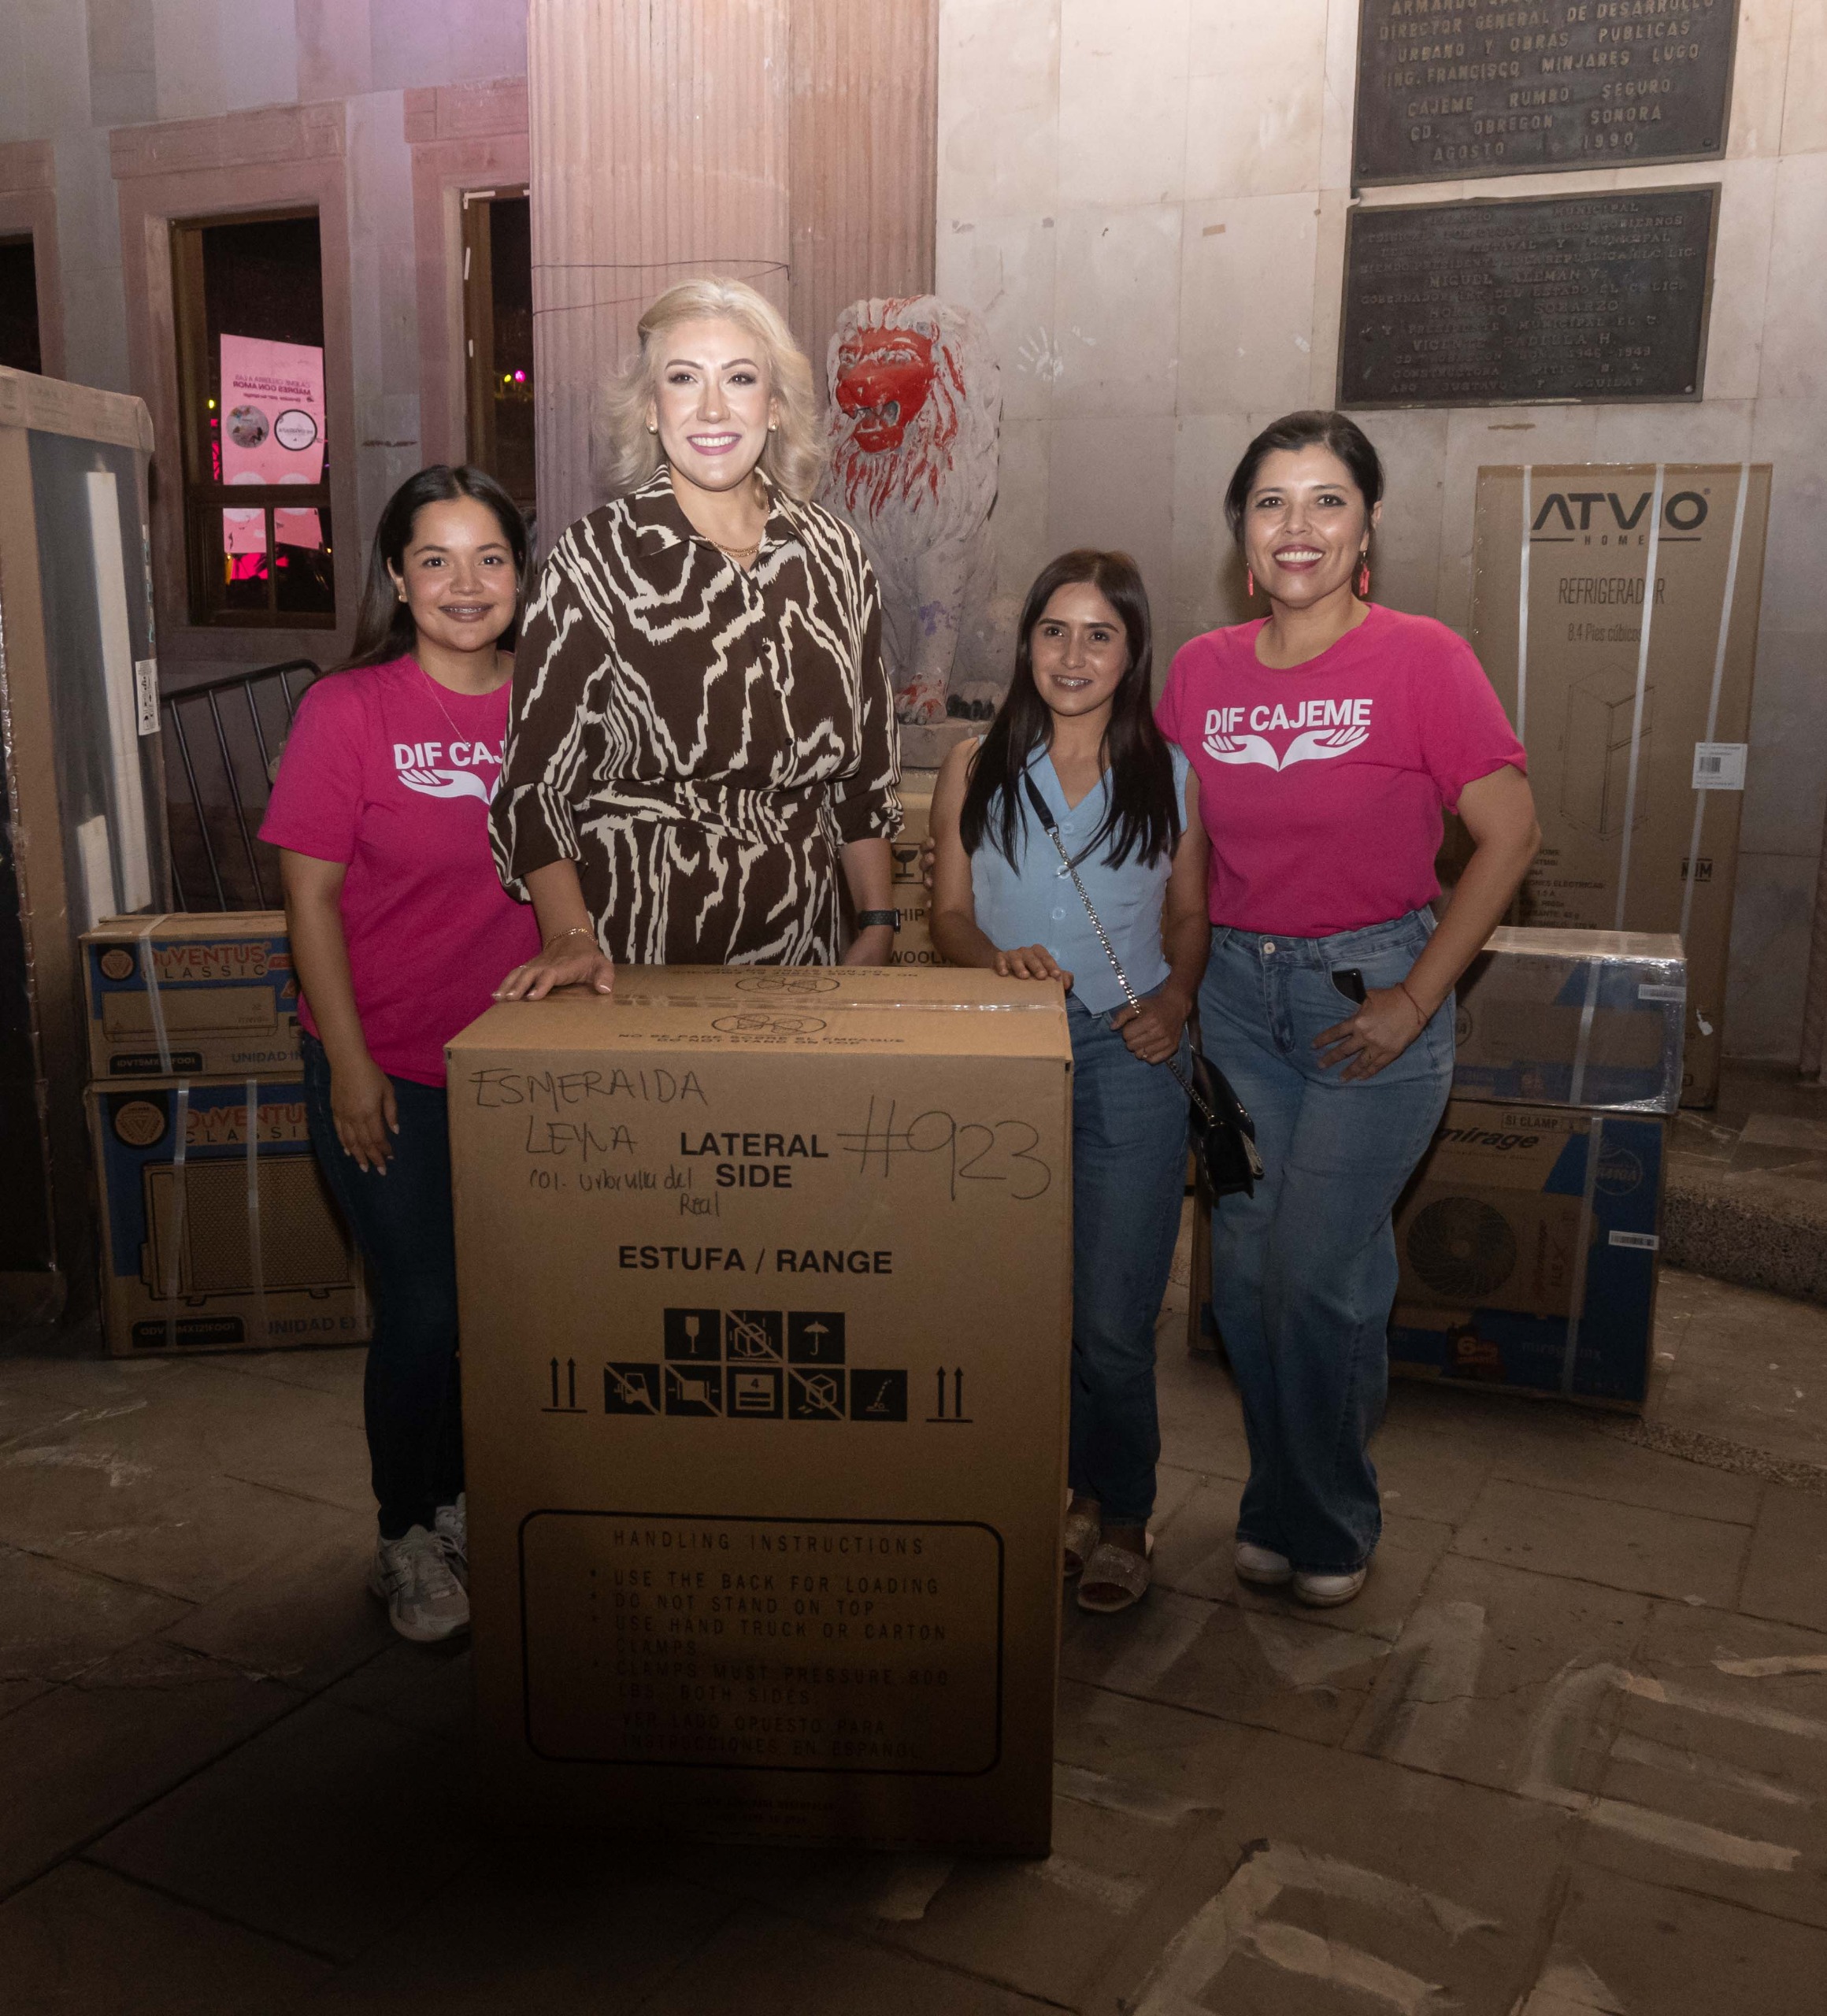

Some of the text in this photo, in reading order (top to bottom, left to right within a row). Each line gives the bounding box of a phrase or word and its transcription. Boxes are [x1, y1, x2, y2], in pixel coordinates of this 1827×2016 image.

[1379, 0, 1714, 41] DIRECTOR GENERAL DE DESARROLLO
[1398, 20, 1691, 63] URBANO Y OBRAS PUBLICAS
[1427, 61, 1520, 83] FRANCISCO
[1541, 50, 1630, 72] MINJARES
[1652, 43, 1700, 63] LUGO
[1407, 79, 1671, 117] CAJEME RUMBO SEGURO
[1473, 114, 1553, 135] OBREGON
[1590, 105, 1662, 125] SONORA
[1432, 131, 1634, 161] AGOSTO 1990
[1599, 215, 1684, 230] GOBIERNOS
[1557, 239, 1566, 249] Y
[1429, 274, 1493, 287] MIGUEL
[1510, 269, 1580, 284] ALEMAN
[1519, 317, 1605, 331] MUNICIPAL
[1532, 491, 1708, 531] ATVO
[1584, 535, 1645, 546] HOME
[1558, 577, 1666, 605] REFRIGERADR
[1584, 623, 1605, 641] Pies
[1204, 699, 1373, 735] DIF CAJEME
[394, 740, 505, 769] DIF CAJ
[1681, 862, 1713, 878] NM
[143, 965, 265, 979] LASSIC
[232, 1051, 287, 1063] UNIDAD
[185, 1126, 297, 1143] CLASI
[1520, 1117, 1558, 1128] CLAMP
[680, 1132, 828, 1158] LATERAL
[837, 1095, 1051, 1202] #923
[716, 1163, 792, 1188] SIDE
[680, 1191, 720, 1217] Real
[619, 1245, 893, 1275] ESTUFA / RANGE
[750, 1378, 760, 1390] 4
[613, 1530, 924, 1555] HANDLING INSTRUCTIONS
[614, 1569, 939, 1595] USE THE BACK FOR LOADING
[615, 1593, 874, 1617] DO NOT STAND ON TOP
[615, 1615, 947, 1641] USE HAND TRUCK OR CARTON
[616, 1637, 698, 1655] CLAMPS
[616, 1659, 698, 1677] CLAMPS
[713, 1663, 768, 1681] MUST
[784, 1665, 892, 1685] PRESSURE
[680, 1685, 732, 1702] BOTH
[672, 1712, 720, 1730] LADO
[735, 1714, 821, 1734] OPUESTO
[837, 1718, 885, 1736] PARA
[794, 1739, 817, 1757] EN
